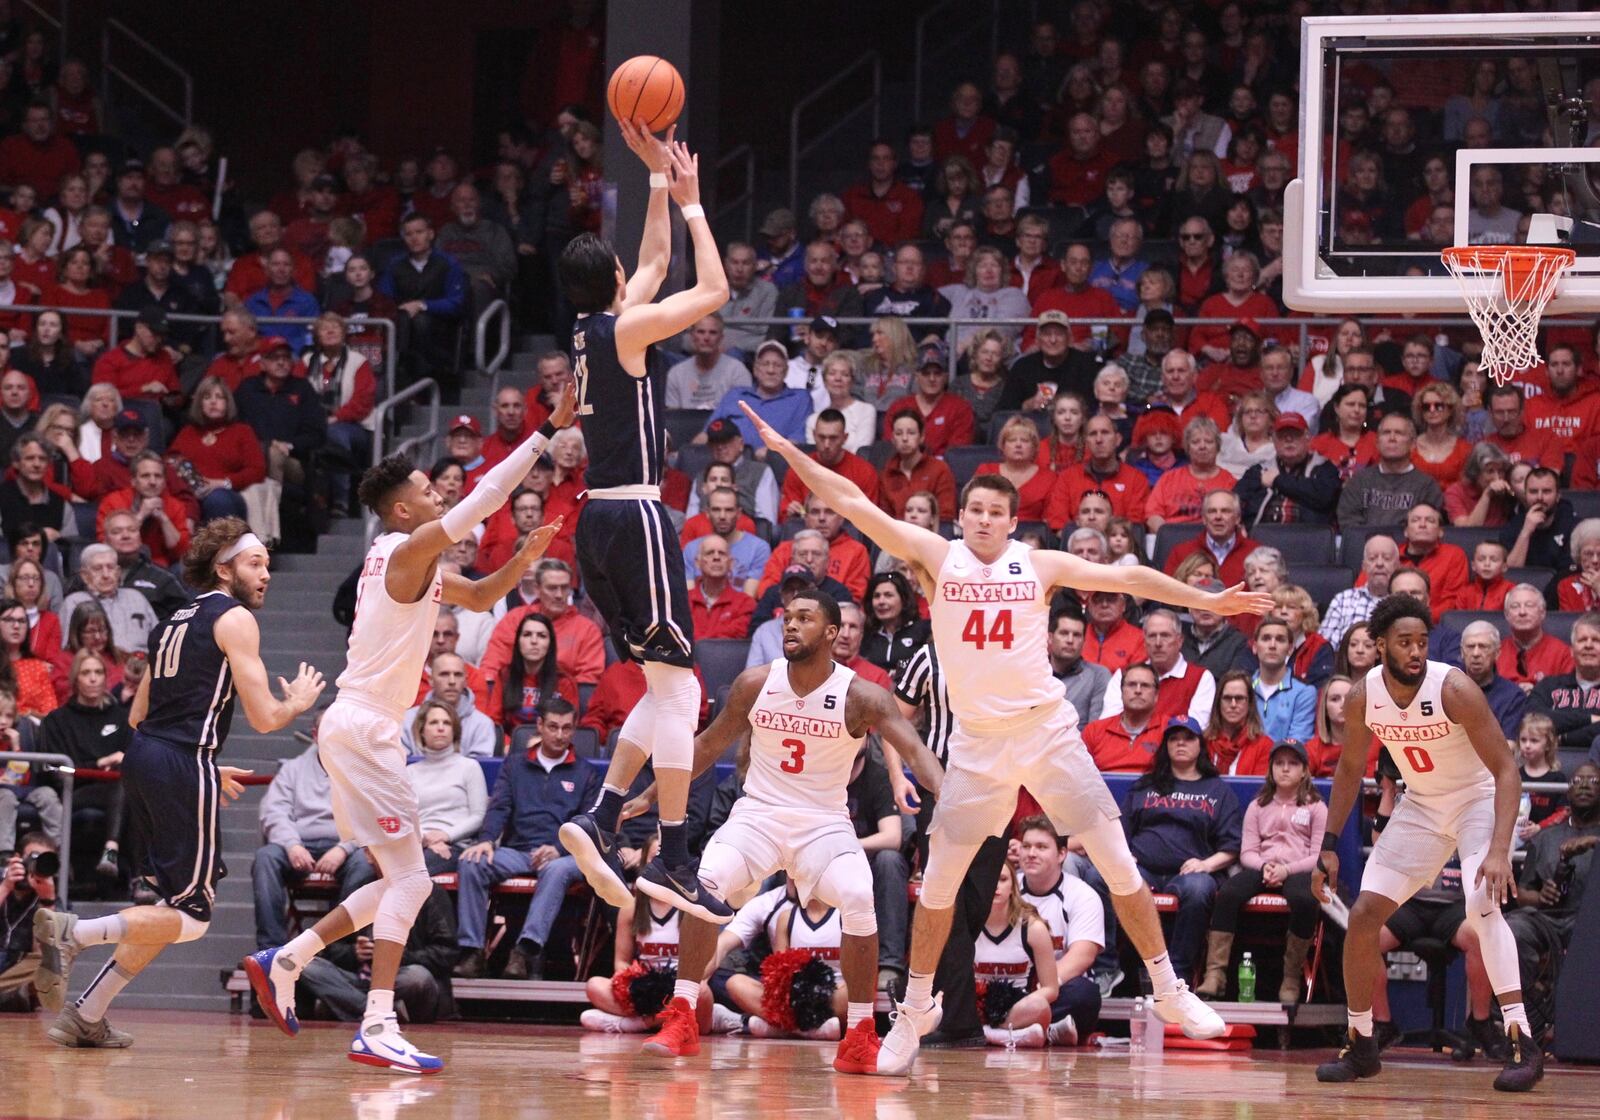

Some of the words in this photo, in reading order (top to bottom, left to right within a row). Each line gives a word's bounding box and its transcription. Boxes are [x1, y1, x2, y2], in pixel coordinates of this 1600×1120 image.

[573, 354, 594, 416] 12
[943, 581, 1036, 603] DAYTON
[962, 609, 1014, 650] 44
[153, 622, 188, 679] 10
[823, 694, 837, 710] 5
[1420, 700, 1434, 717] 5
[755, 708, 842, 738] DAYTON
[1370, 721, 1450, 742] DAYTON
[780, 738, 806, 774] 3
[1403, 746, 1435, 773] 0
[1143, 795, 1216, 818] DAYTON
